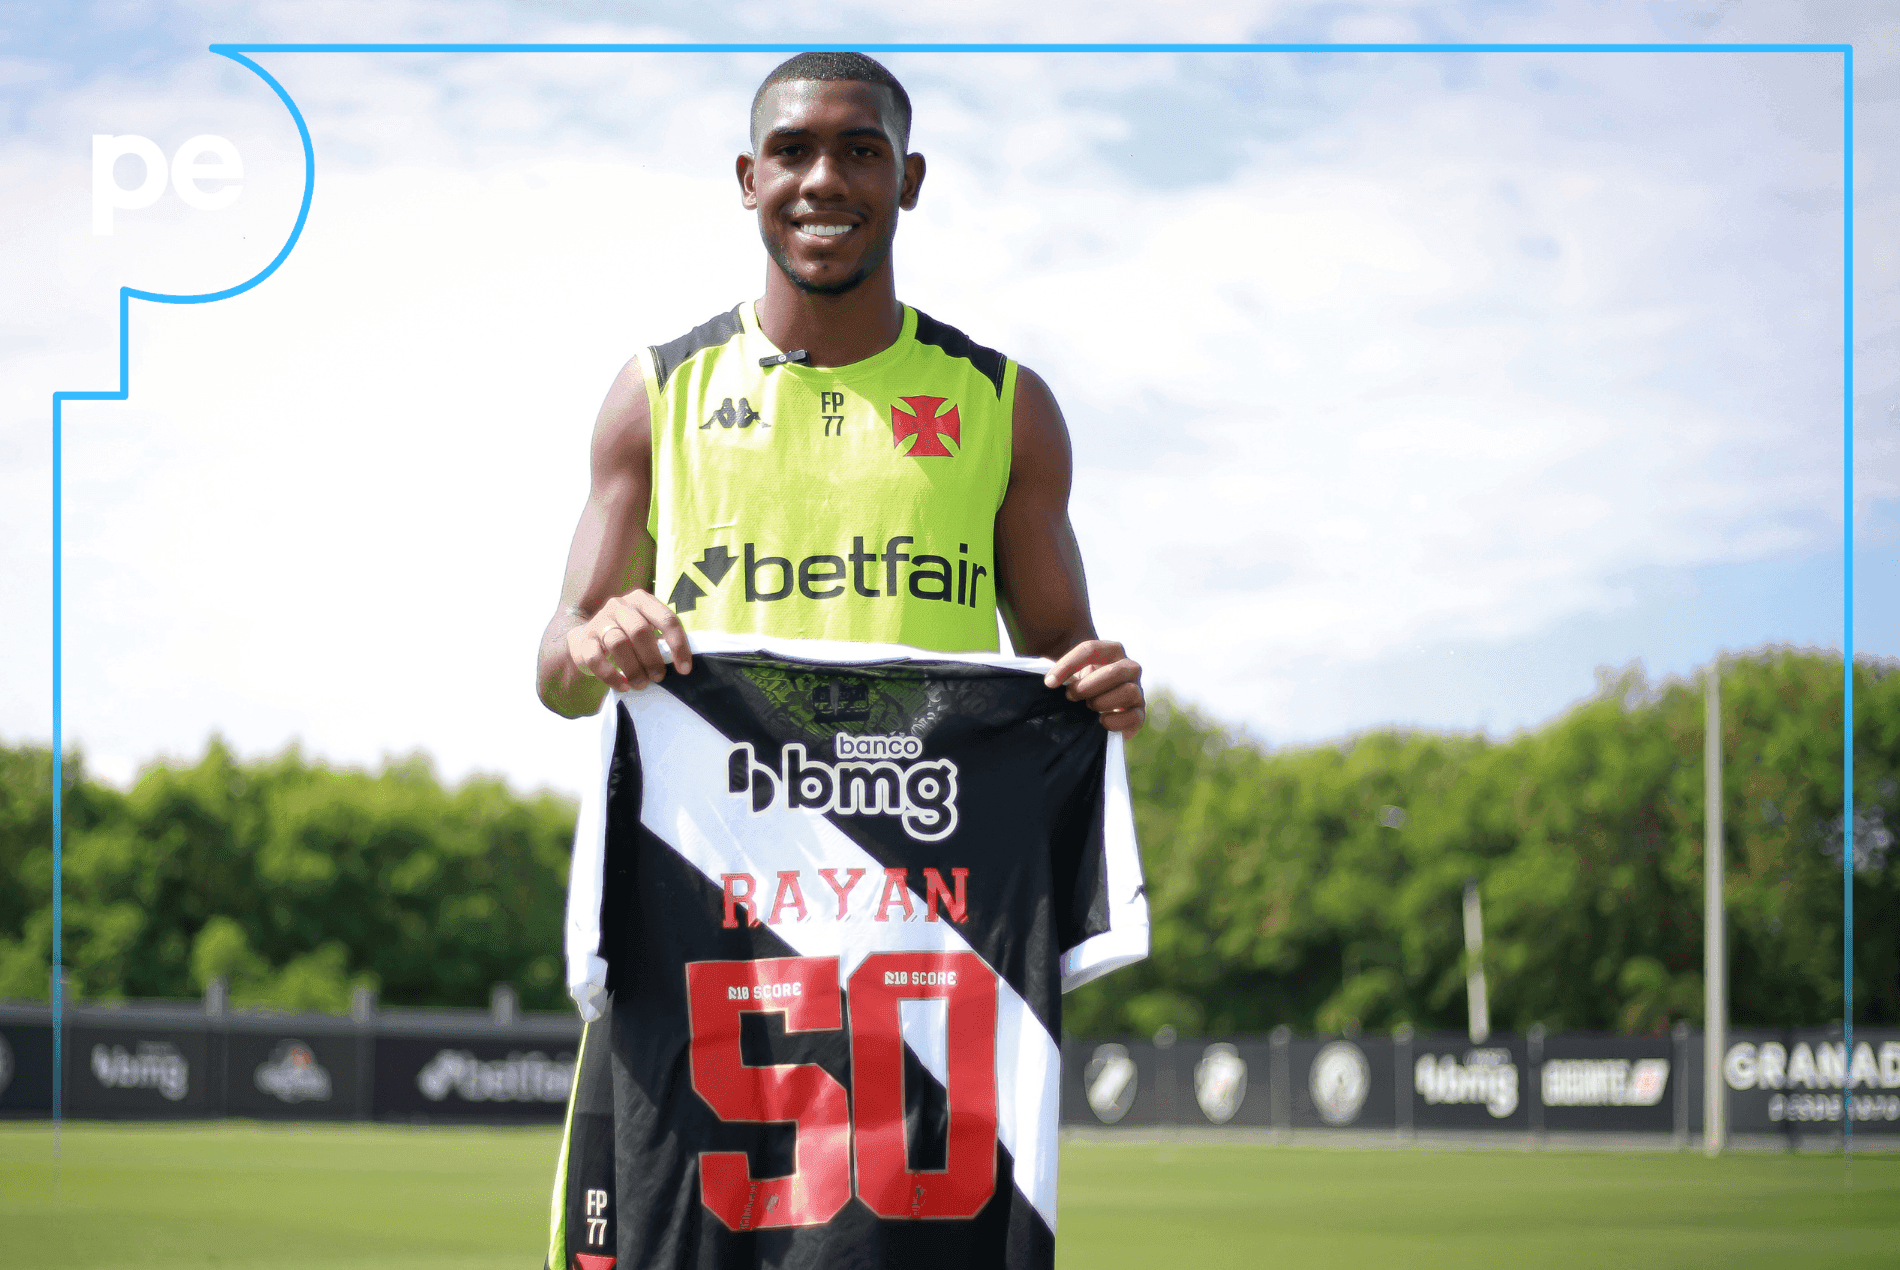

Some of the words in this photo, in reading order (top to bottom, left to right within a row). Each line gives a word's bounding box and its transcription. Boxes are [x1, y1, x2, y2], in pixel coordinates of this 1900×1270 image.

[820, 391, 845, 414] FP
[821, 415, 845, 437] 77
[743, 535, 988, 609] betfair
[836, 732, 923, 760] banco
[720, 867, 970, 929] RAYAN
[753, 982, 802, 999] SCORE
[911, 971, 957, 986] SCORE
[685, 950, 999, 1232] 50
[586, 1189, 608, 1217] FP
[586, 1218, 608, 1246] 77
